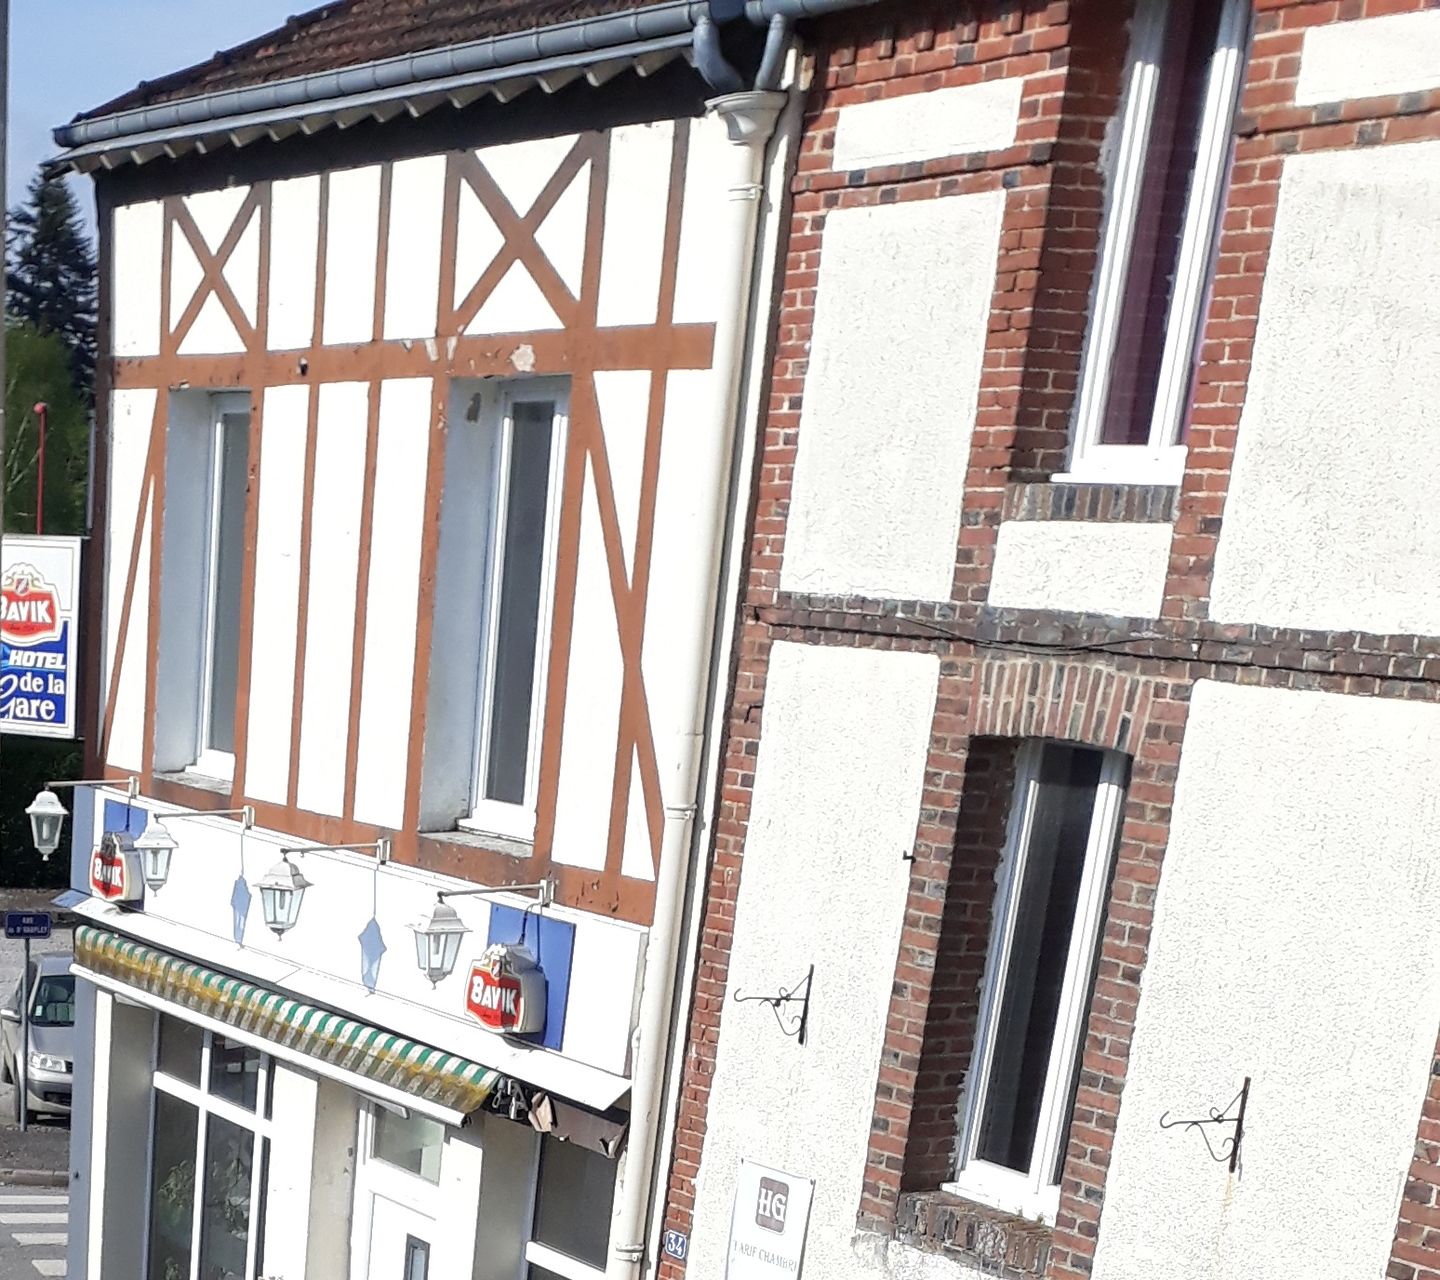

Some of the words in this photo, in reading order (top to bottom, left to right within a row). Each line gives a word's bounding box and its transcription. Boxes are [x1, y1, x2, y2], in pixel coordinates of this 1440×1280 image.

[8, 649, 67, 670] HOTEL
[19, 671, 45, 692] de
[47, 673, 66, 695] la
[470, 975, 518, 1016] BAVIK
[758, 1187, 787, 1222] HG
[668, 1232, 684, 1256] 34
[732, 1240, 758, 1258] TARIF
